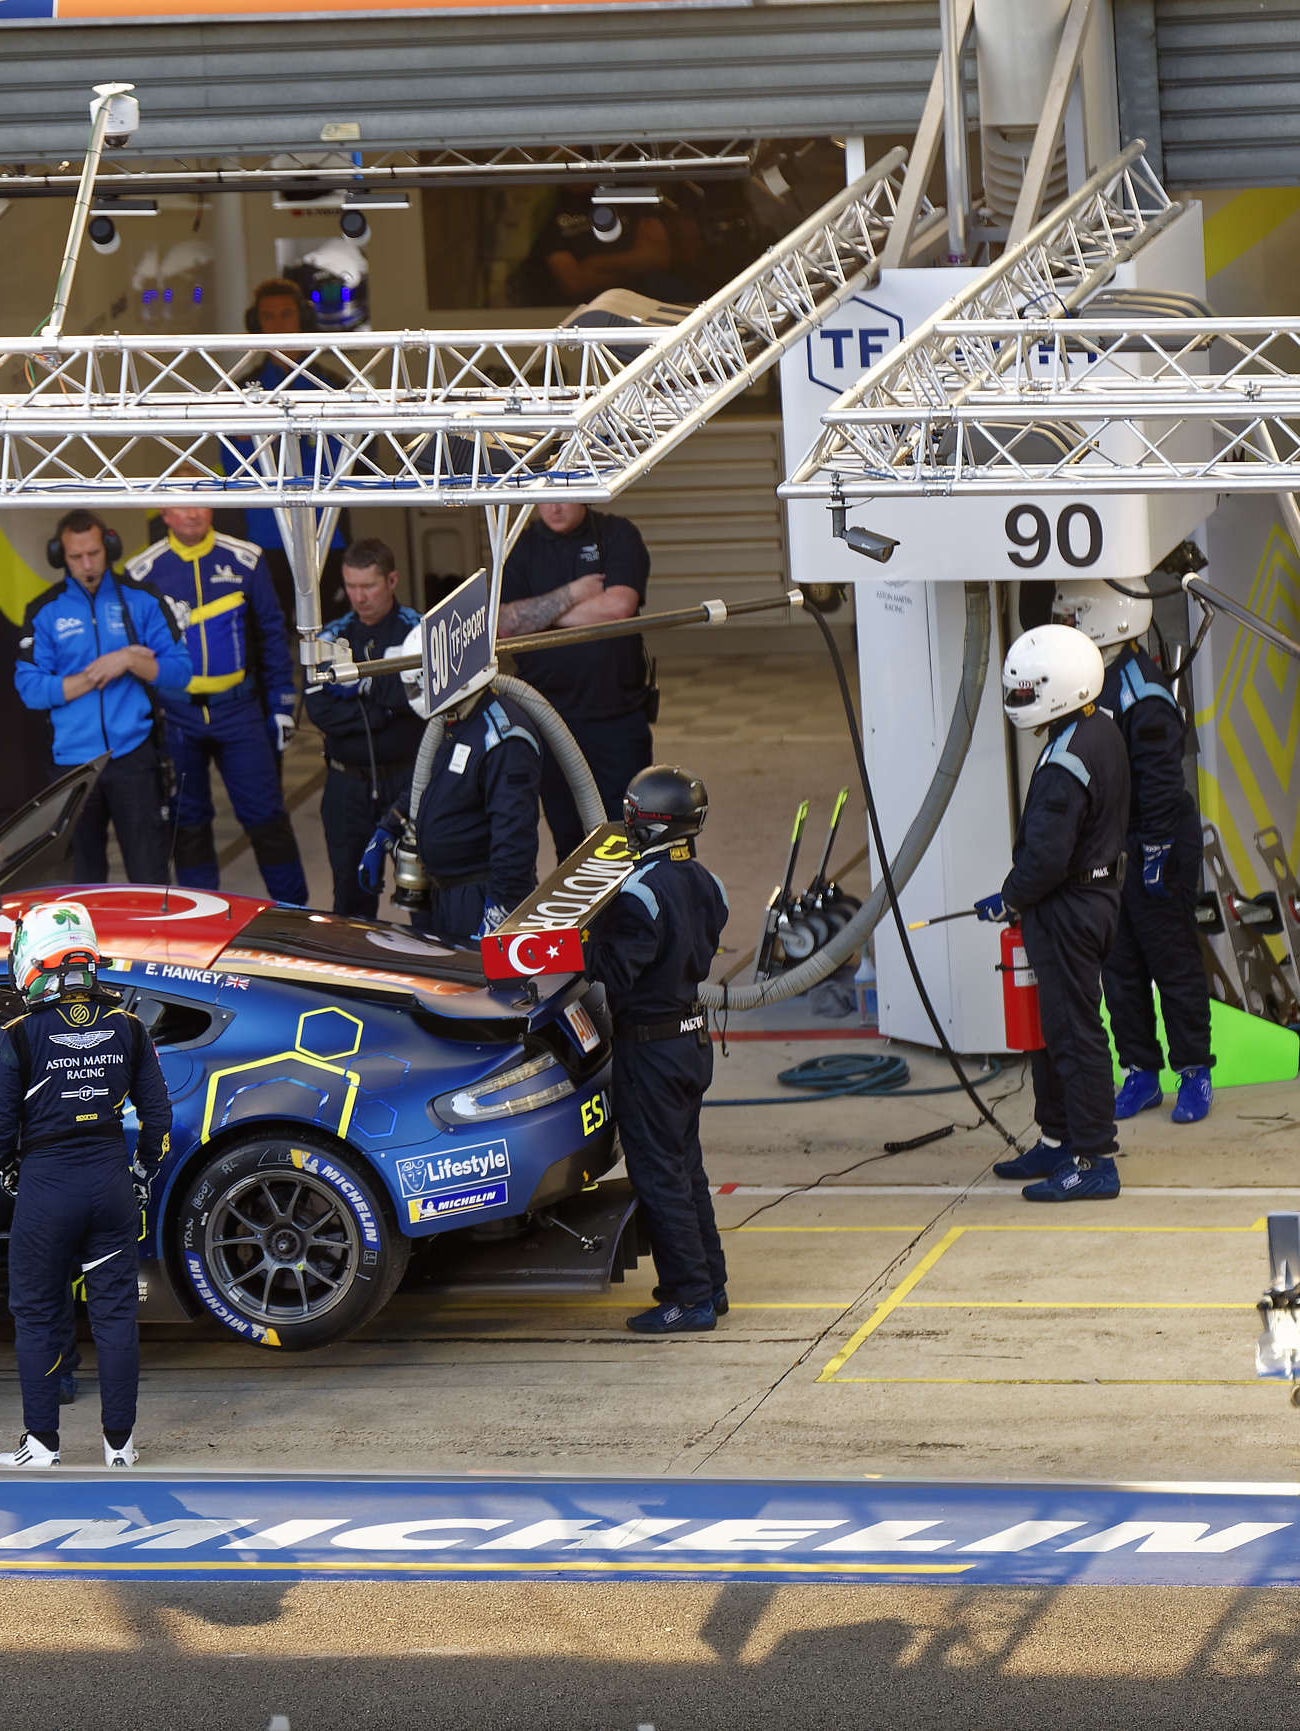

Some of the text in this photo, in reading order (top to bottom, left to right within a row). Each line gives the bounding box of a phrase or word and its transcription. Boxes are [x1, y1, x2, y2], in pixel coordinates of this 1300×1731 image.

[819, 328, 890, 369] TF
[1004, 502, 1104, 568] 90
[431, 604, 488, 696] 90 TF SPORT
[145, 961, 223, 986] E. HANKEY
[46, 1054, 124, 1071] ASTON MARTIN
[66, 1067, 105, 1080] RACING
[81, 1089, 91, 1097] TF
[426, 1149, 507, 1182] Lifestyle
[321, 1166, 378, 1243] MICHELIN
[437, 1191, 497, 1211] MICHELIN
[188, 1259, 249, 1333] MICHELIN
